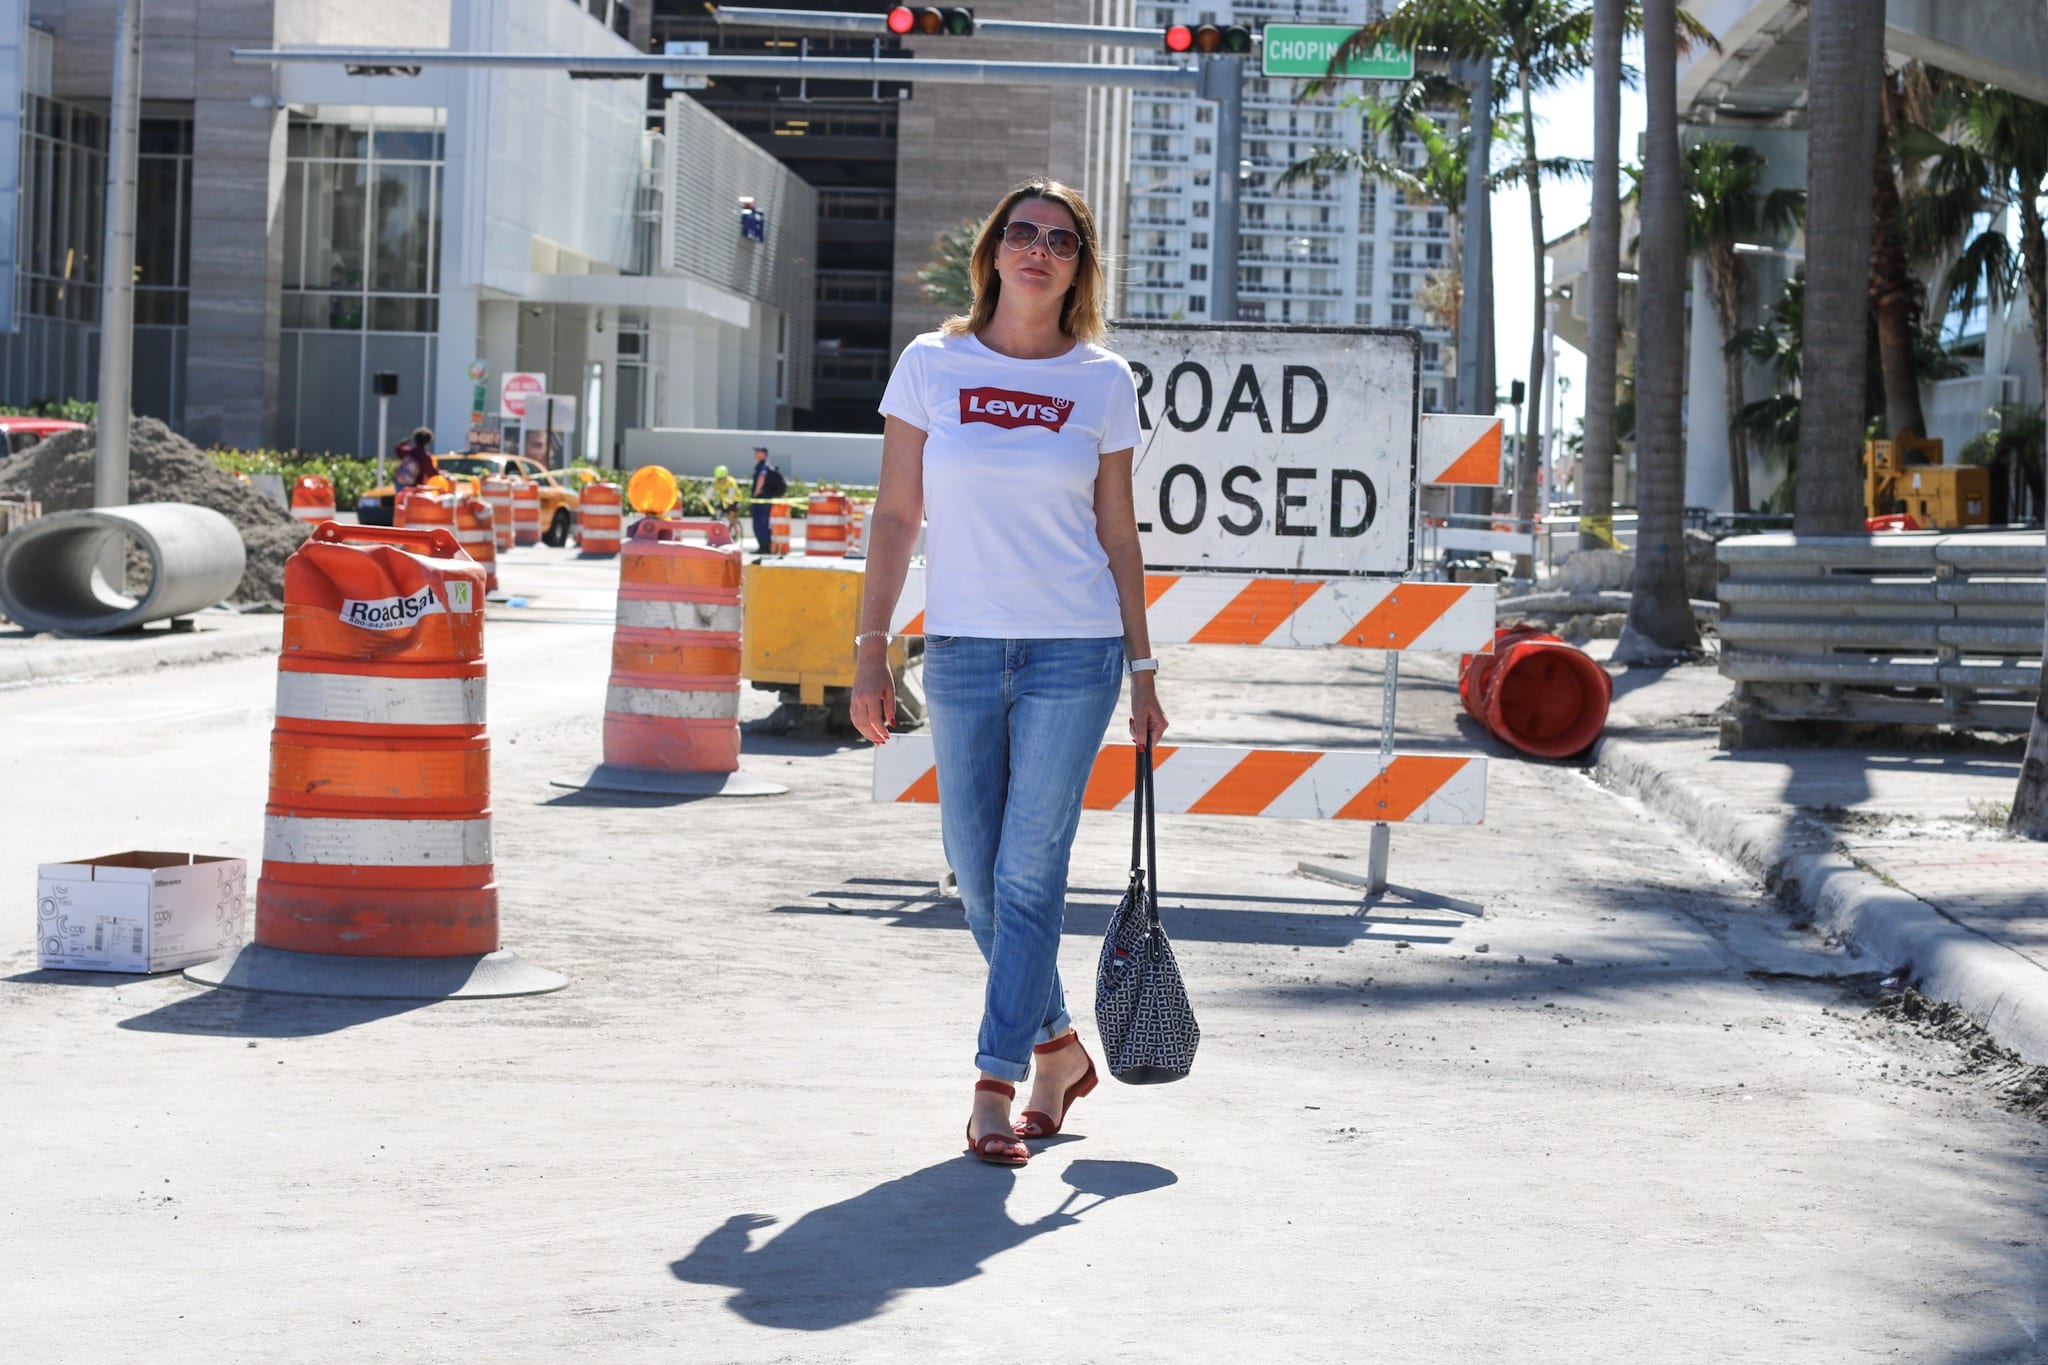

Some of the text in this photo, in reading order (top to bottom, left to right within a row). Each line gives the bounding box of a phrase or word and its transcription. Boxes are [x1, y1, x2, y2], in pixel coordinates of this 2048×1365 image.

[1269, 40, 1338, 61] CHOPIN
[1128, 360, 1329, 434] ROAD
[1137, 463, 1378, 538] OSED
[350, 587, 434, 622] RoadSaf
